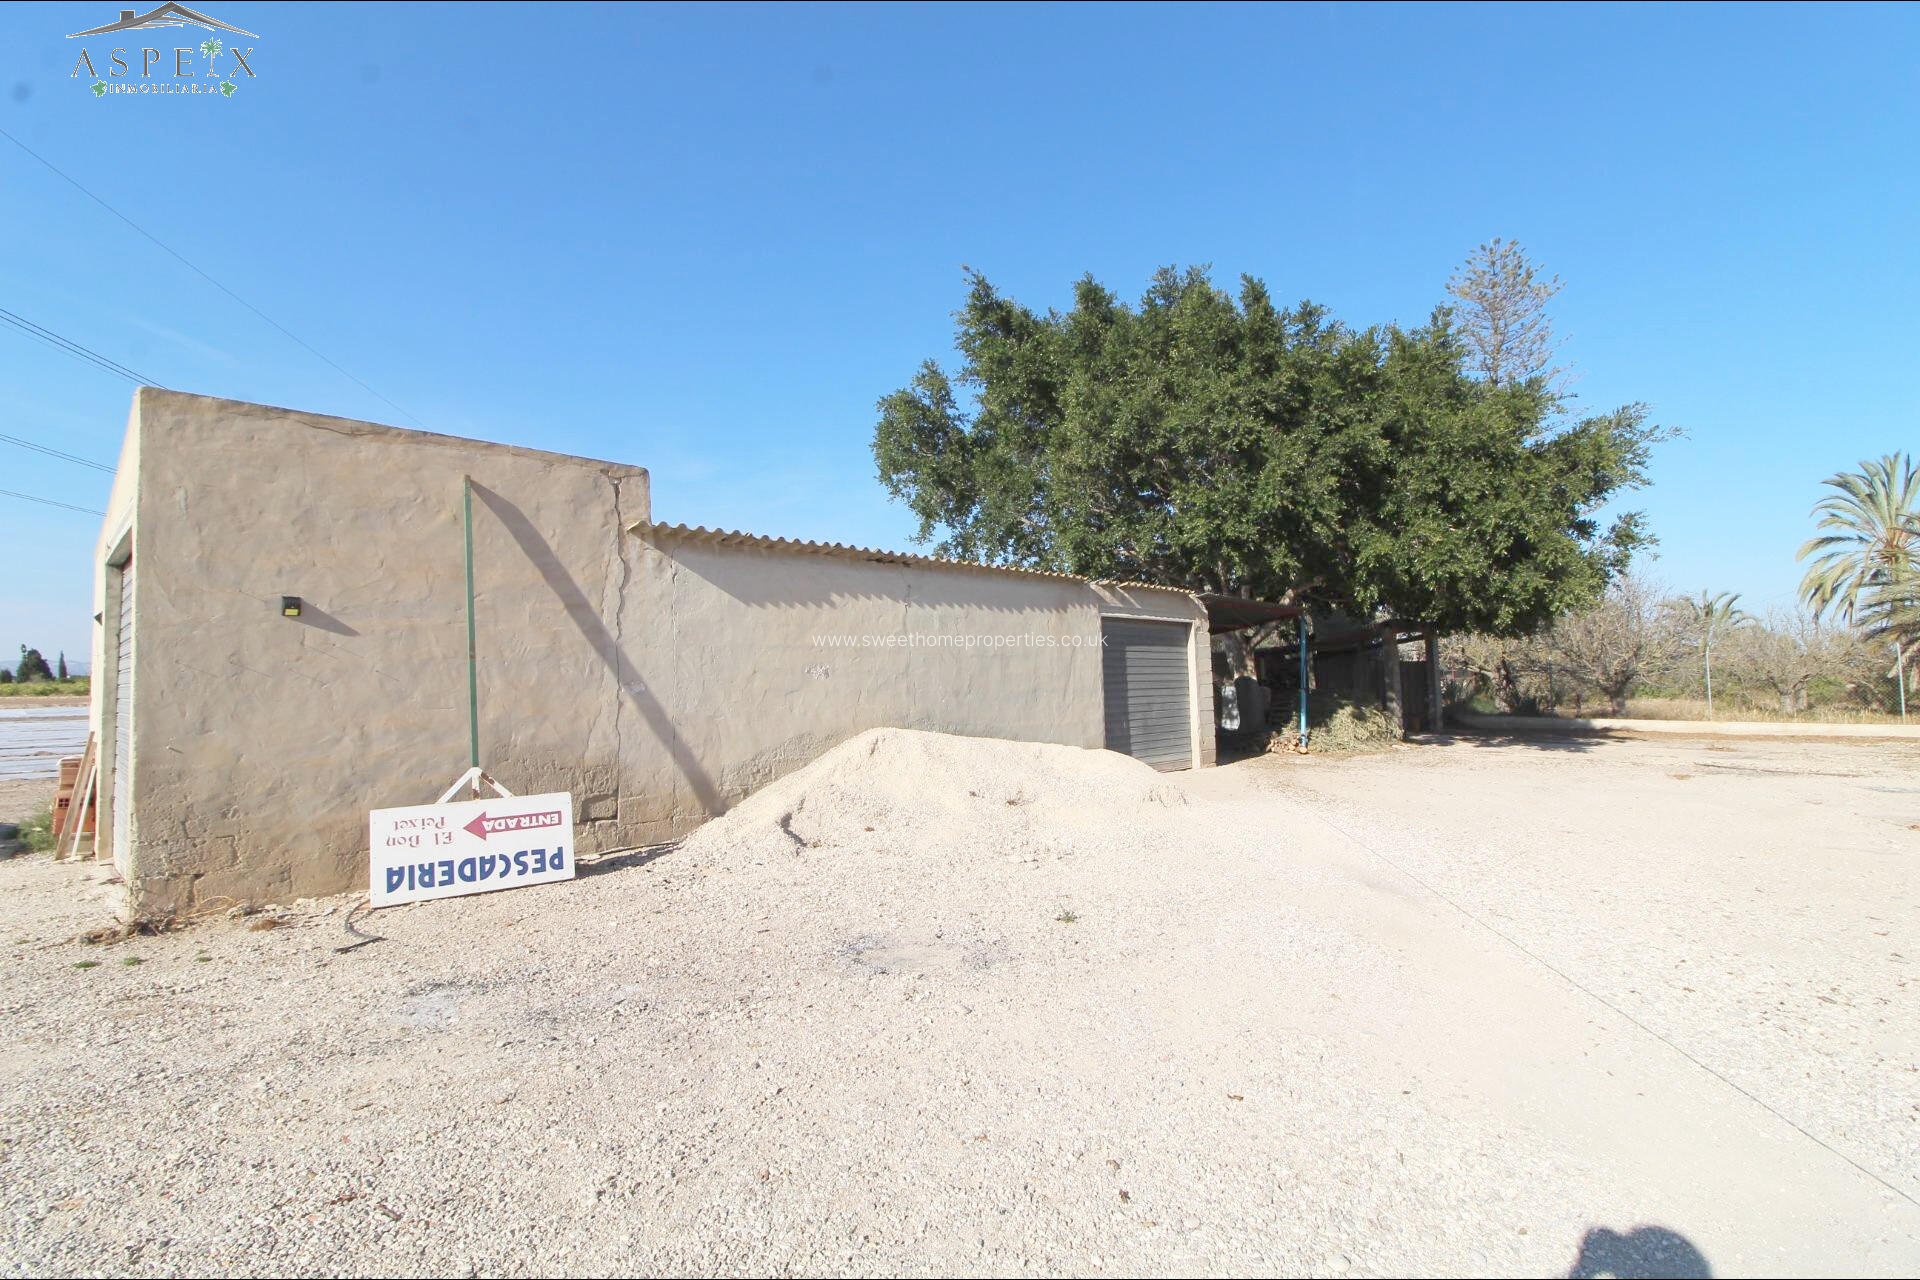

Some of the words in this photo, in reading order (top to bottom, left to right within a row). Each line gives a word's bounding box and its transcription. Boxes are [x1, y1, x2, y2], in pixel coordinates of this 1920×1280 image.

[482, 813, 559, 832] ENTRADA
[386, 833, 420, 848] Bon
[434, 832, 453, 845] El
[386, 847, 563, 893] PESCADERIA
